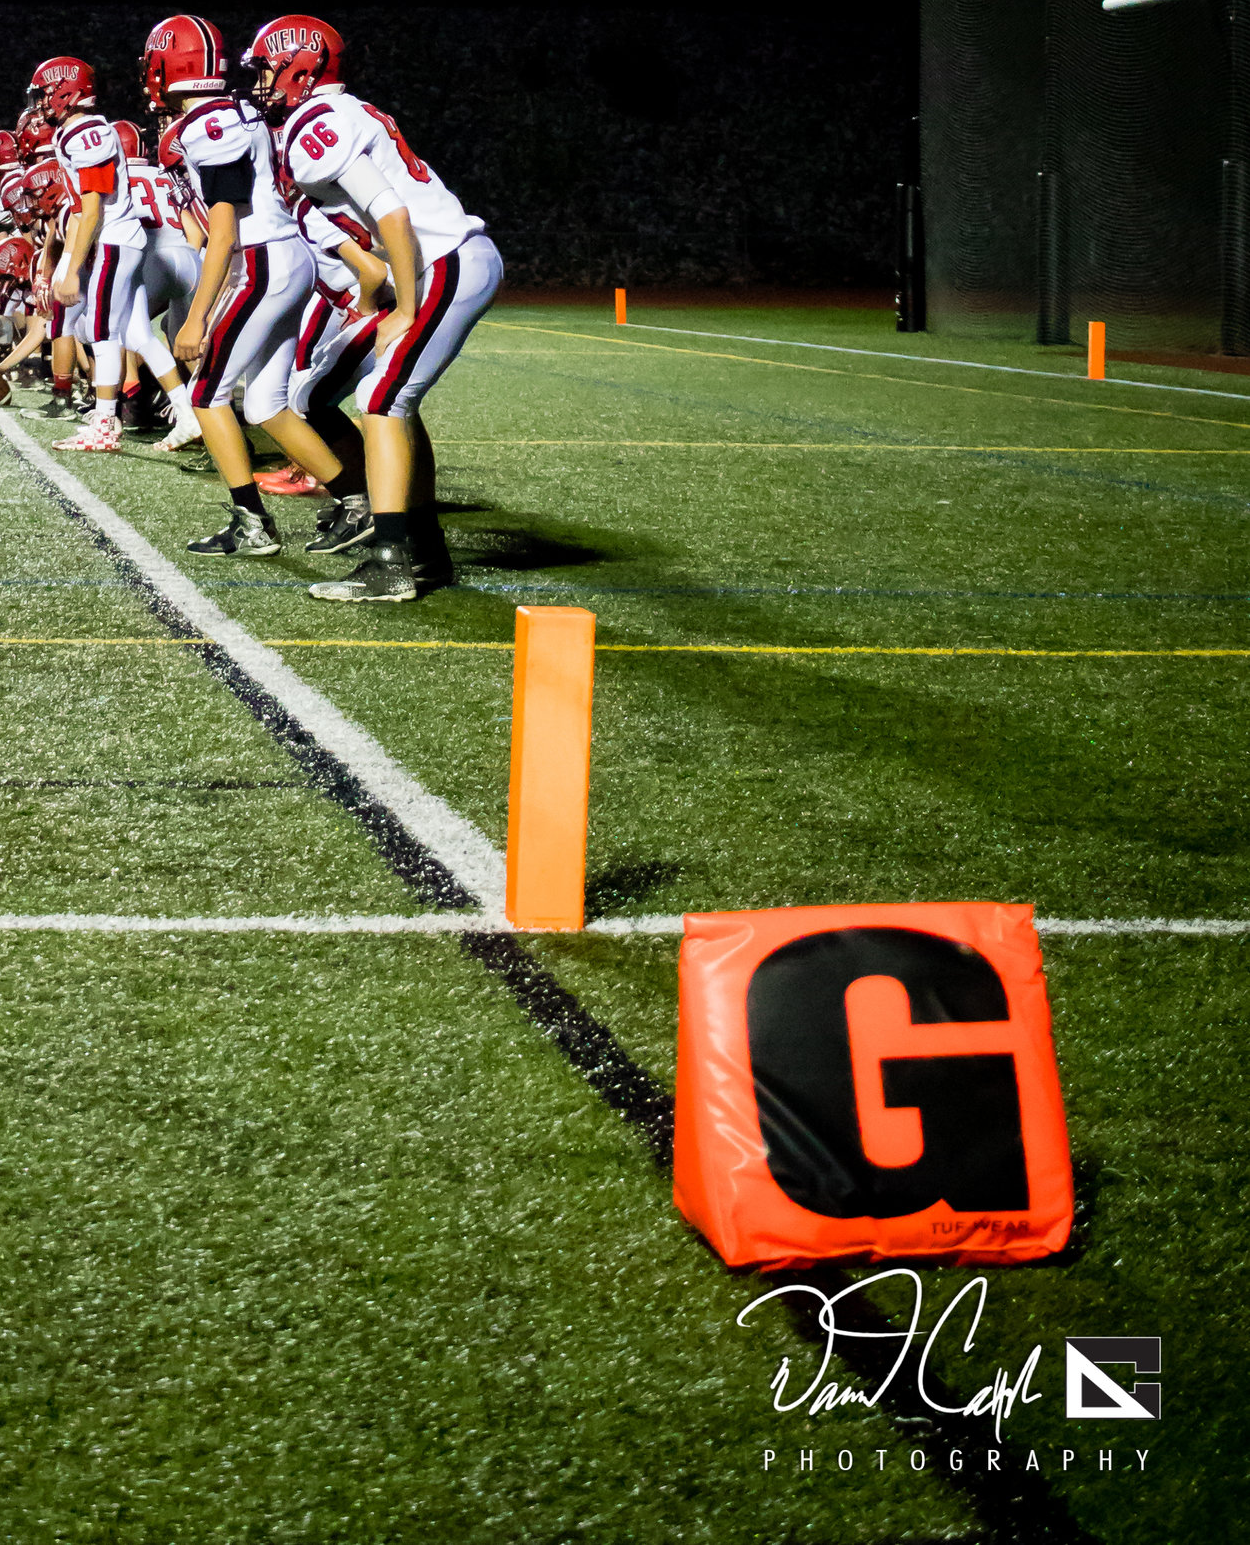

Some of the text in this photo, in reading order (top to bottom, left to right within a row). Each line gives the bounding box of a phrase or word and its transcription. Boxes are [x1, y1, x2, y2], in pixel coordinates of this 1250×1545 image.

[265, 28, 322, 57] WELLS
[42, 65, 79, 84] WELLS
[81, 130, 102, 151] 10
[204, 117, 224, 141] 6
[300, 121, 339, 161] 86
[746, 925, 1031, 1219] G
